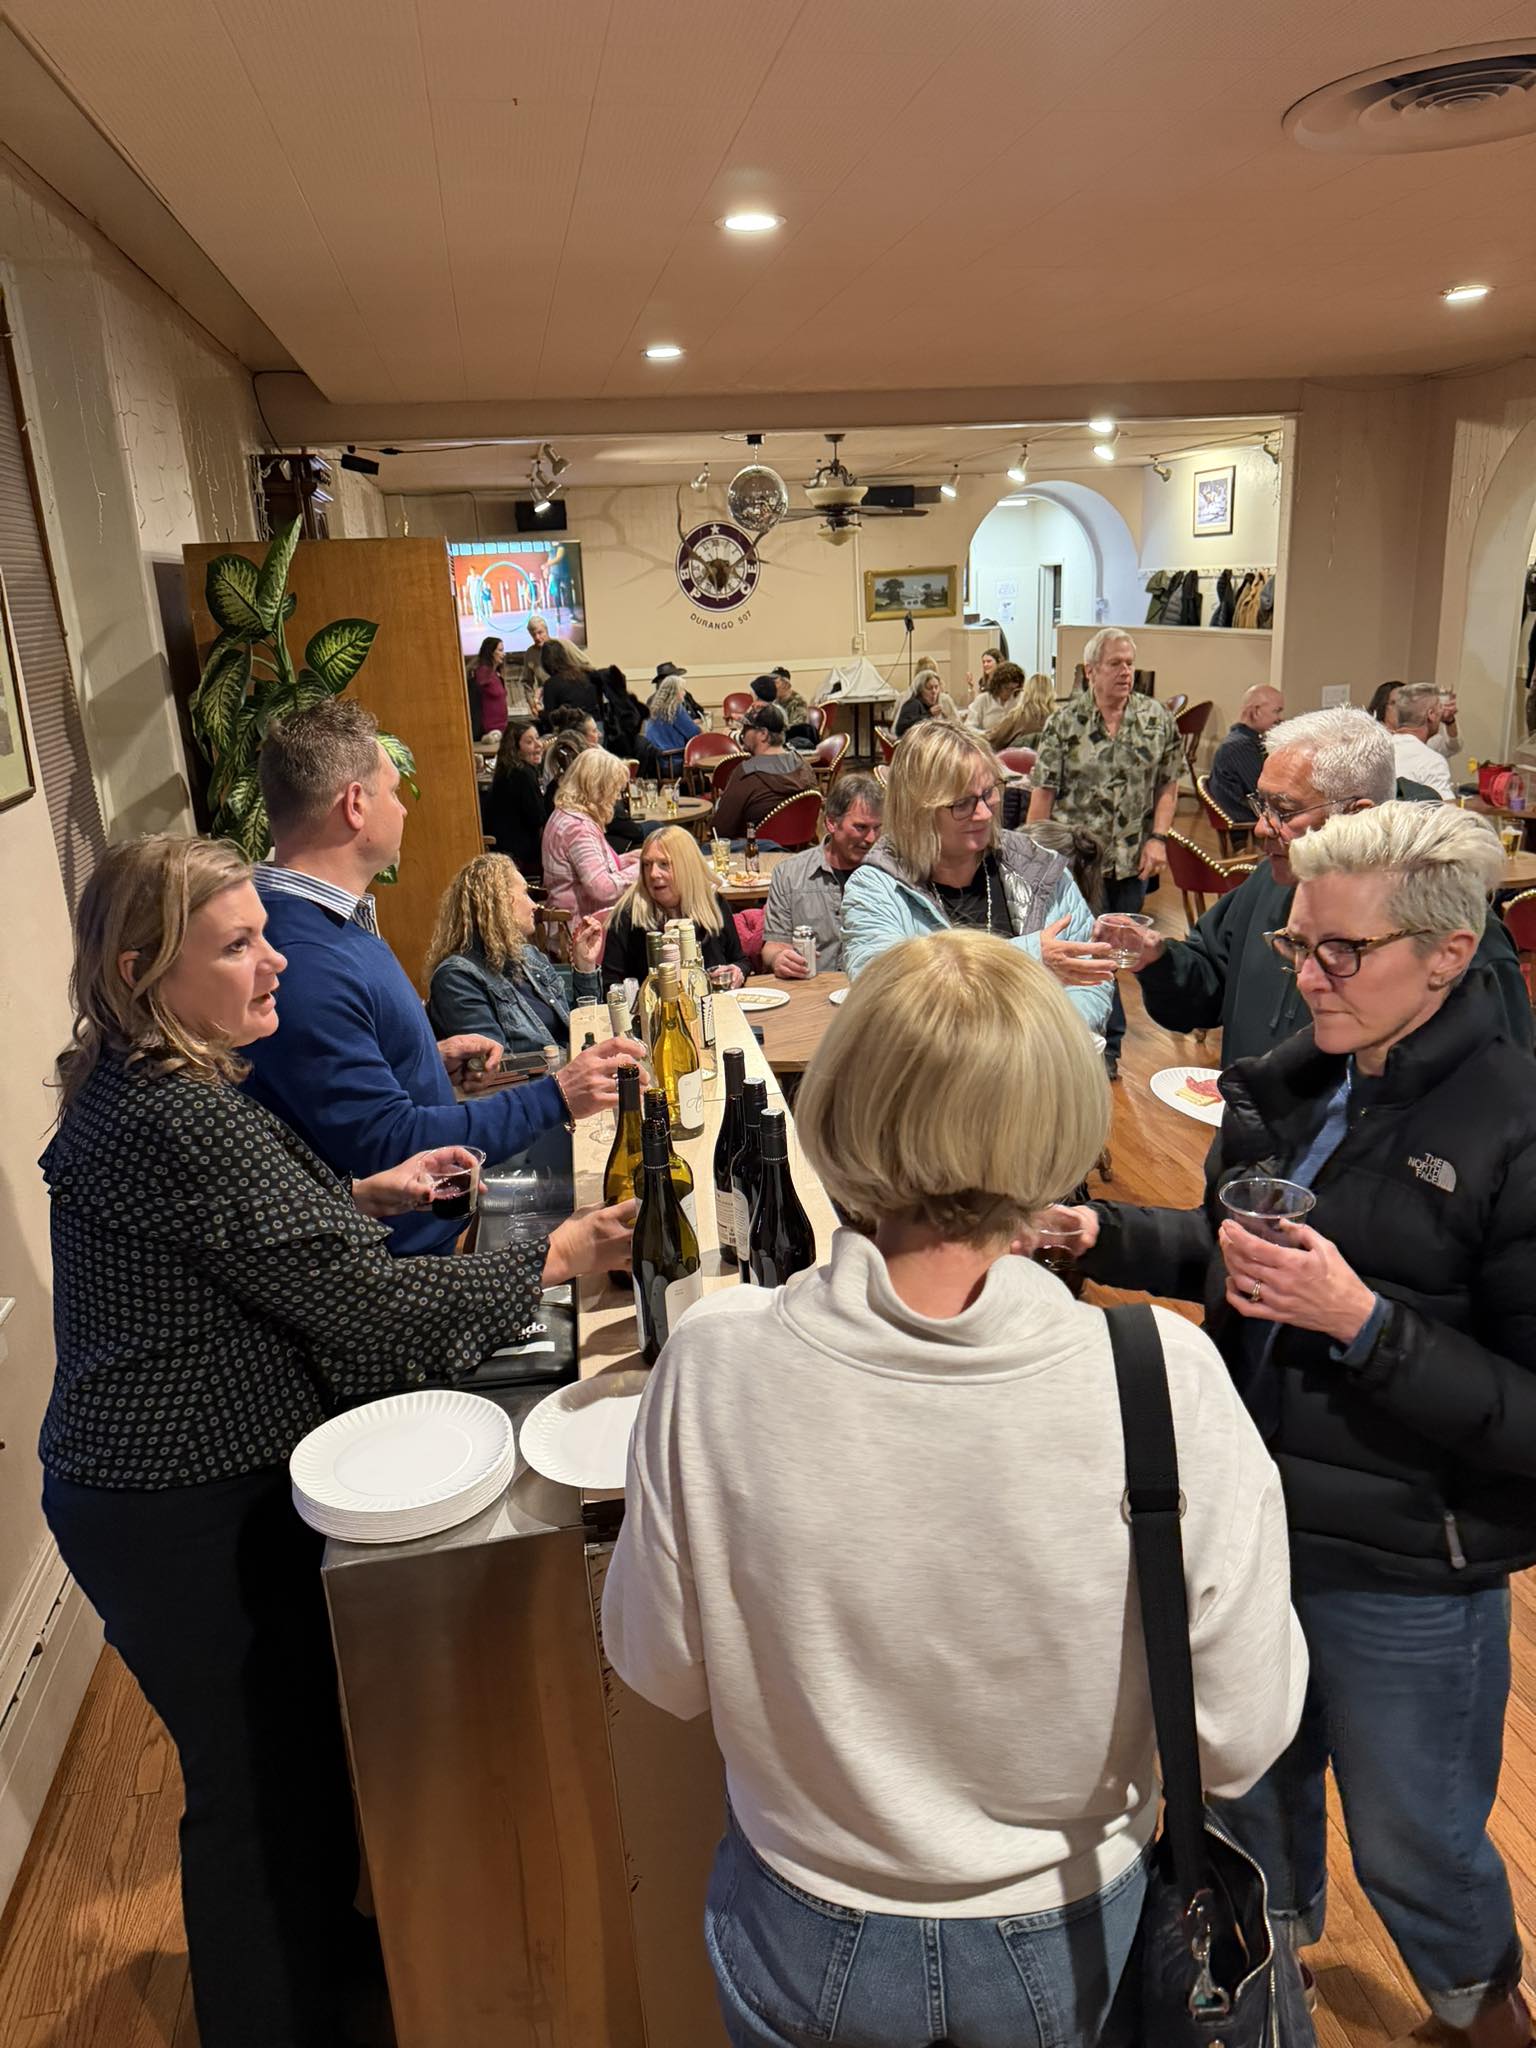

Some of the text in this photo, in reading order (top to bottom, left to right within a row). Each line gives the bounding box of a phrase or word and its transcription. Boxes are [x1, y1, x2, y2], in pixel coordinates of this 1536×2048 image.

[690, 610, 752, 630] DURANGO 507
[1407, 1156, 1440, 1177] NORTH
[1425, 1152, 1443, 1168] THE
[1415, 1168, 1440, 1184] FACE
